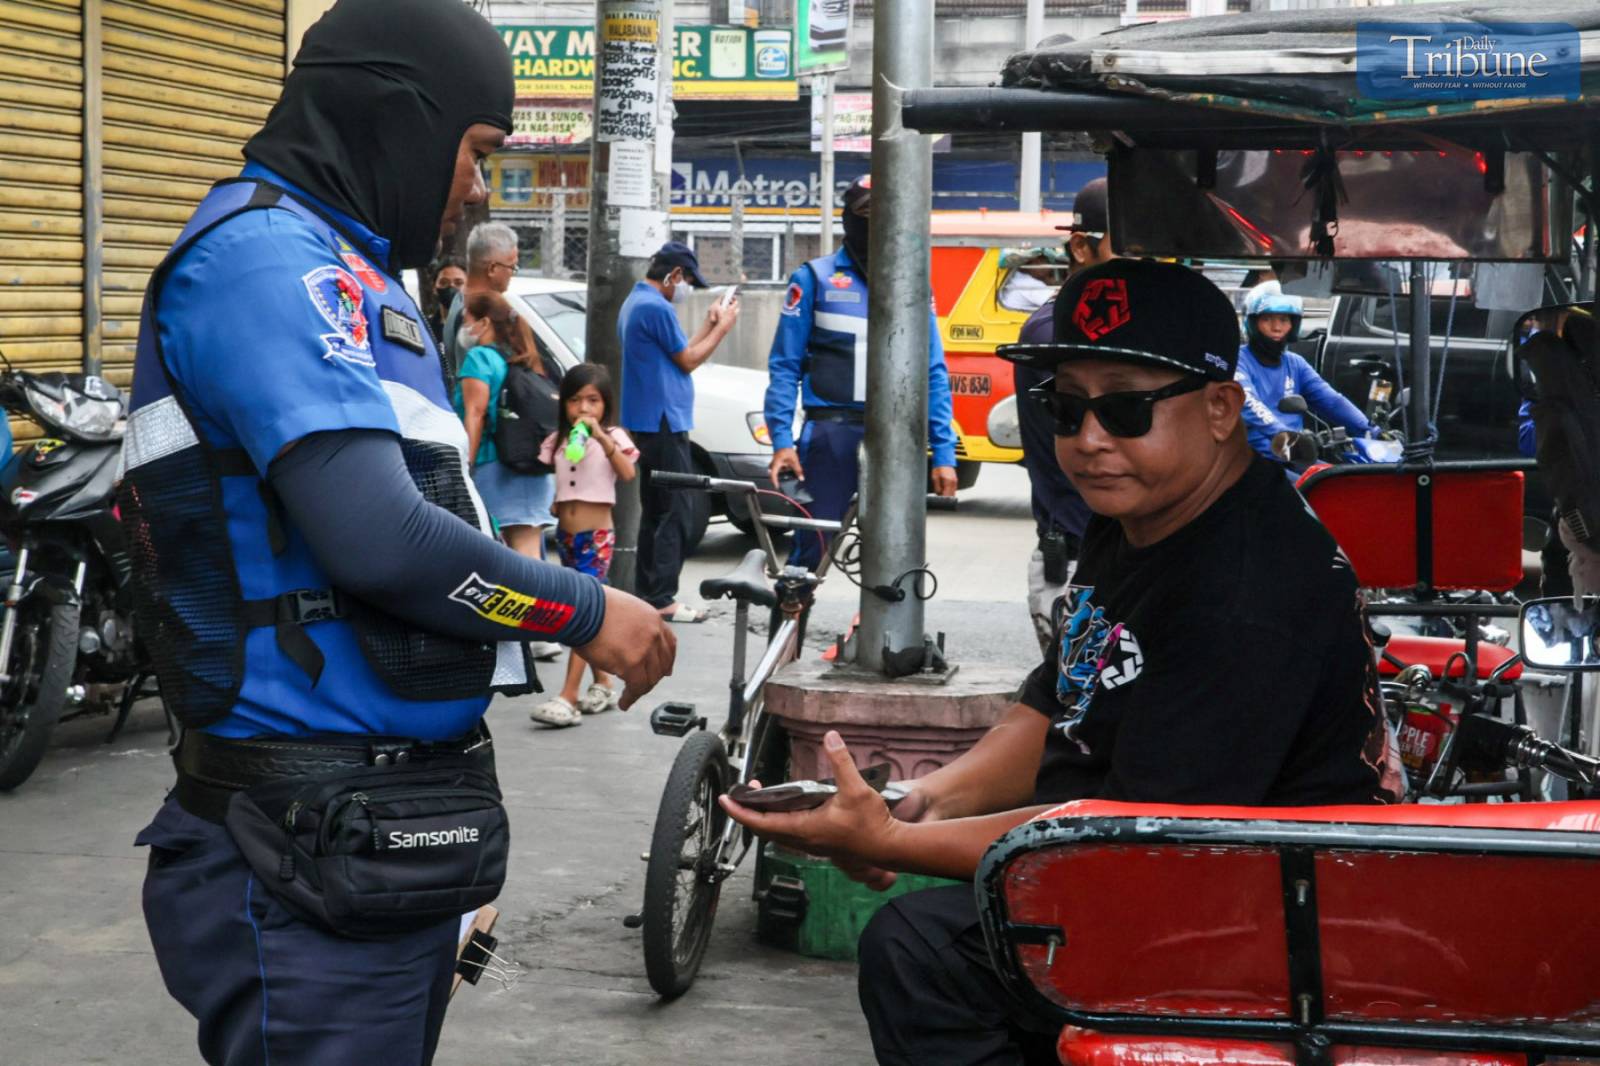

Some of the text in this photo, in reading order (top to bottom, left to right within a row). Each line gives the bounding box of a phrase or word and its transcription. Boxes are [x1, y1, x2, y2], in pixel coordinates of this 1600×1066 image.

[514, 59, 597, 76] HARDW
[535, 112, 547, 121] SA
[696, 170, 853, 207] Metroba
[496, 598, 565, 627] GARAGE
[1402, 724, 1431, 748] PPLE
[388, 826, 479, 849] Samsonite
